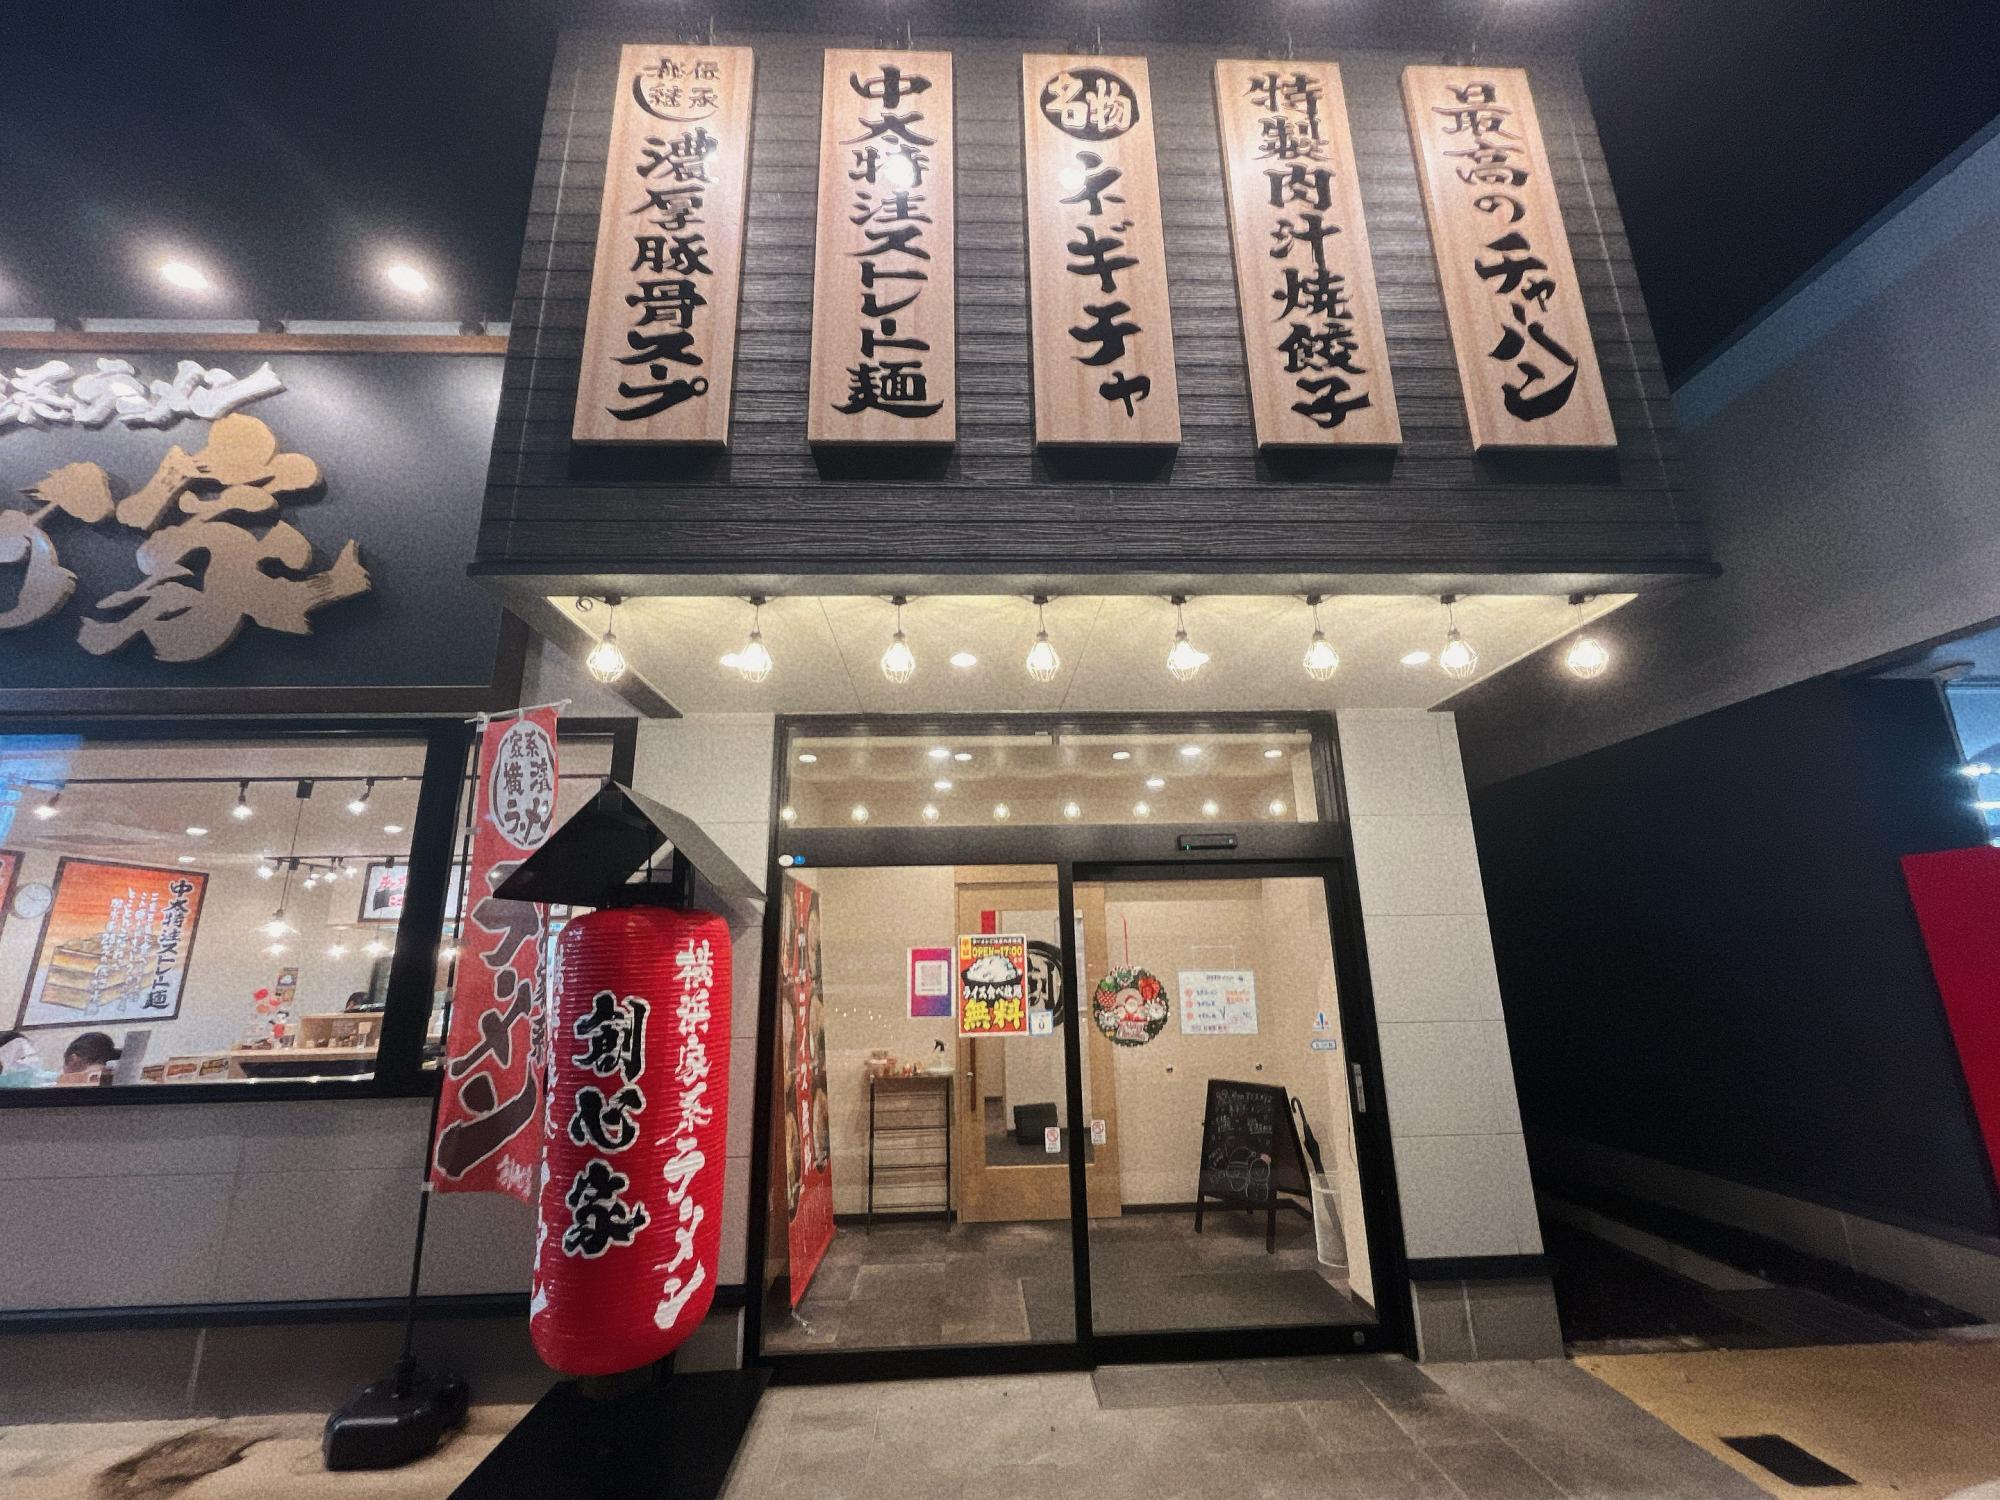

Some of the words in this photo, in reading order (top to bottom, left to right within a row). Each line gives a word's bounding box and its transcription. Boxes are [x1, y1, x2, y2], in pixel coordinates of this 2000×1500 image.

[831, 64, 944, 418] 中太特注ストレート麺
[1046, 74, 1132, 133] 名物
[1248, 70, 1371, 429] 特製肉汁焼餃子
[606, 127, 719, 421] 濃厚豚骨スープ
[1060, 151, 1151, 418] ネギチャ
[1431, 81, 1580, 422] 最高のチャーハン
[510, 730, 539, 758] 家系
[141, 880, 194, 1010] 中太特注ストレート麺
[434, 860, 542, 1182] ラーメン
[963, 997, 1025, 1031] 無料
[654, 939, 714, 1330] 横浜家系ラーメン
